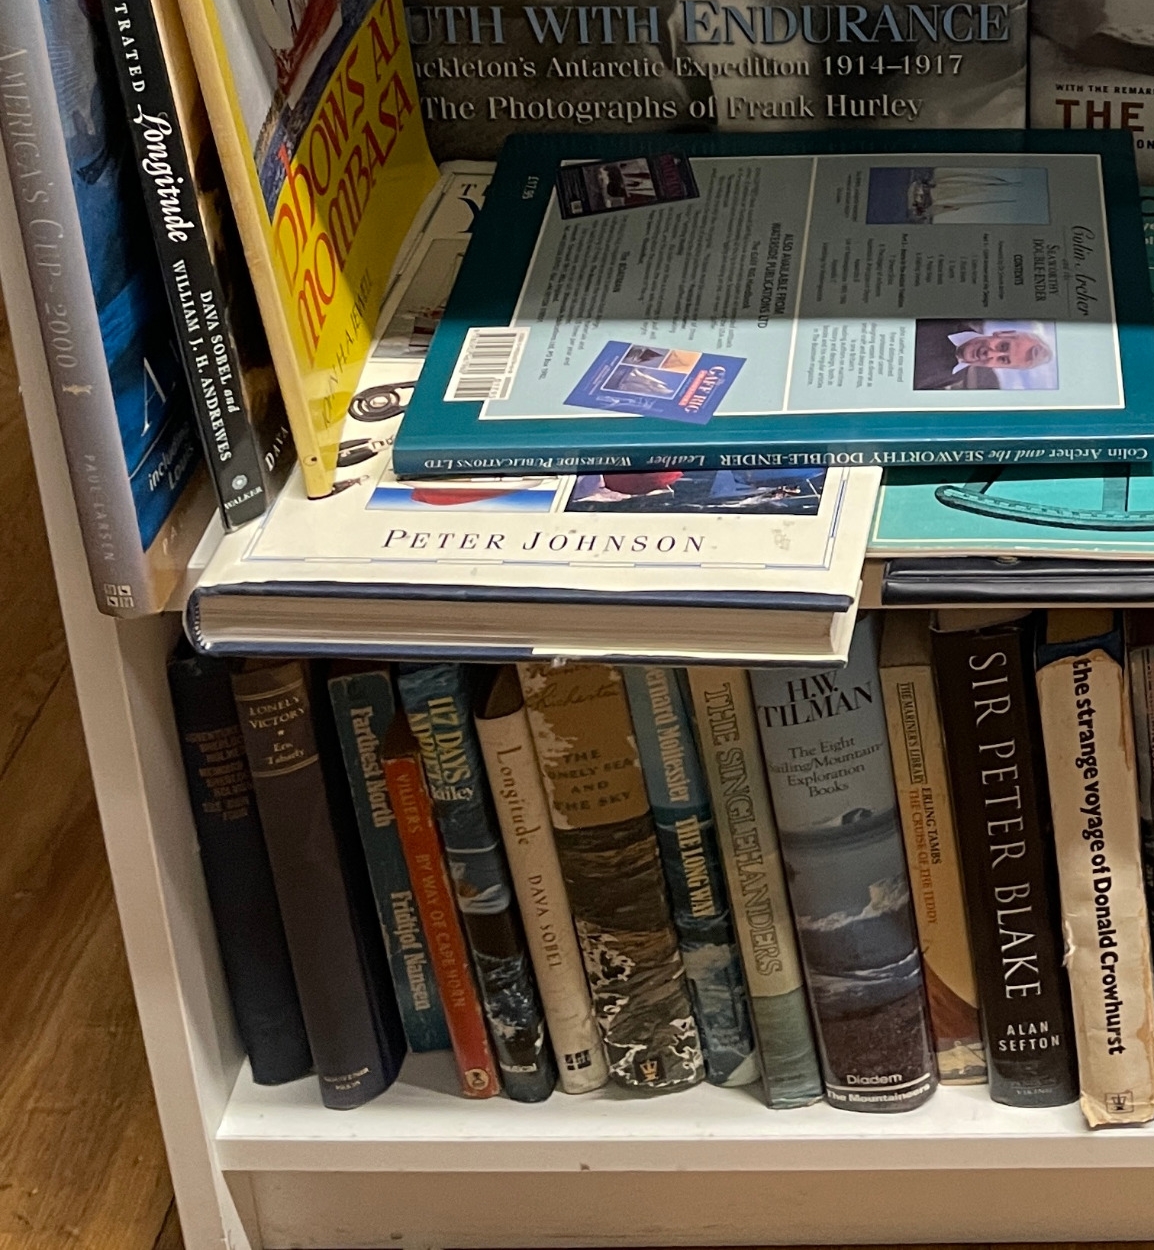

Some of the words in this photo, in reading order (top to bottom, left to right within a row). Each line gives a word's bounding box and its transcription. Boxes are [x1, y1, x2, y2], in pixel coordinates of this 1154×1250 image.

[523, 6, 659, 45] WITH
[1055, 84, 1084, 92] WITH
[1088, 85, 1109, 93] THE
[420, 96, 484, 121] The
[488, 94, 678, 124] Photographs
[688, 94, 718, 120] of
[728, 96, 814, 120] Frank
[825, 93, 923, 121] Hurley
[1055, 99, 1144, 132] THE
[382, 529, 504, 551] PETER
[523, 531, 706, 554] JOHNSON
[757, 682, 874, 728] TILMAN
[968, 651, 1012, 726] SIR
[703, 682, 737, 748] THE
[787, 745, 816, 759] The
[821, 736, 856, 753] Eight
[786, 762, 865, 787] Exploration
[807, 782, 849, 797] Books
[495, 745, 530, 845] Longitude
[978, 738, 1025, 869] PETER
[717, 747, 783, 977] SINGLEHANDERS
[526, 875, 551, 927] DAVA
[539, 925, 562, 970] SOBEL
[994, 883, 1042, 1000] BLAKE
[998, 1035, 1059, 1051] SEFTON
[1006, 1021, 1049, 1036] ALAN
[846, 1071, 903, 1086] Diadem
